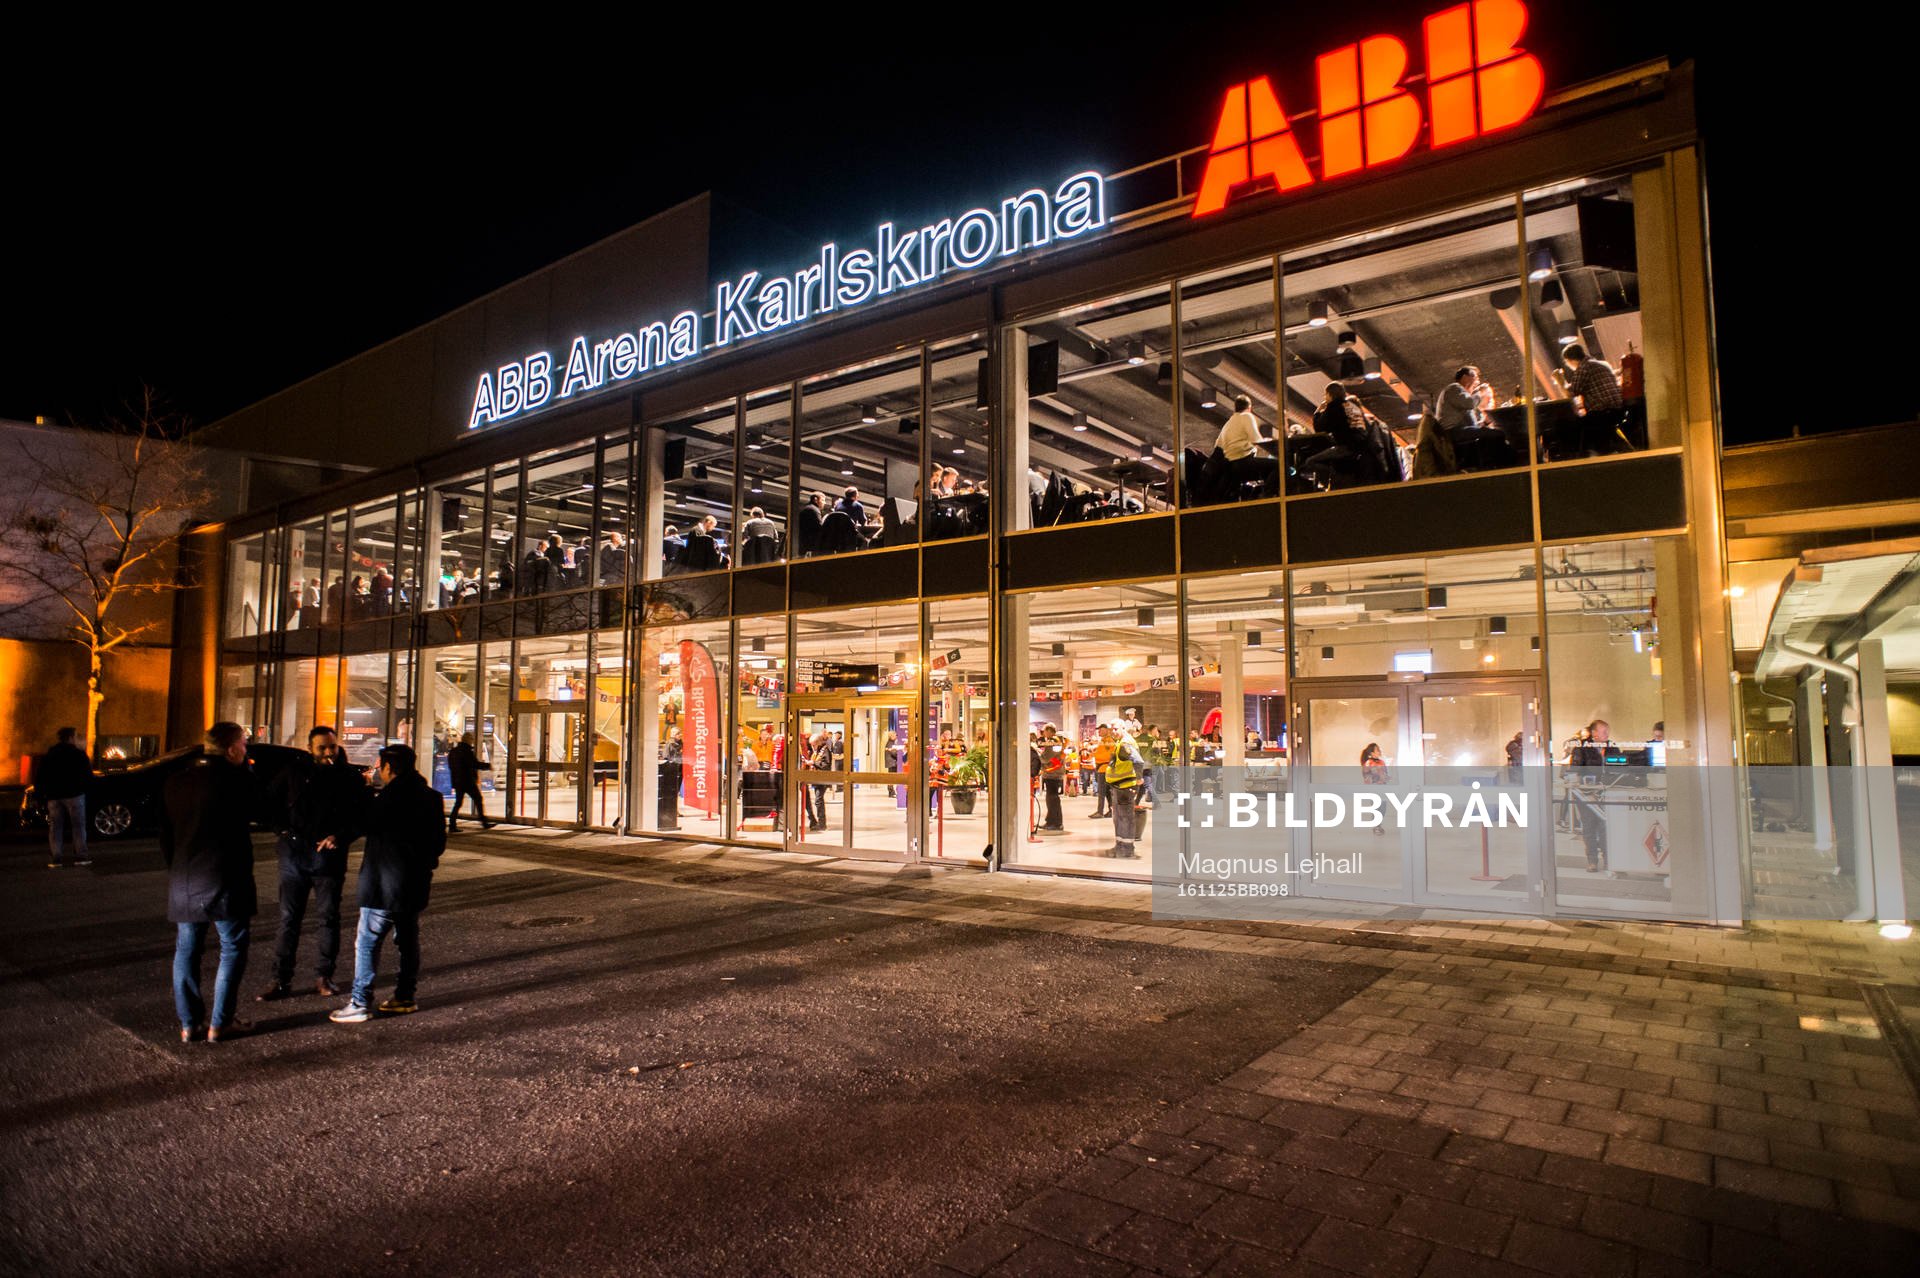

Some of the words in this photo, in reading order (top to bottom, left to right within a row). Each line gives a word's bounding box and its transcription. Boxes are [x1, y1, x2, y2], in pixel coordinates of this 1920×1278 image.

[1192, 0, 1544, 217] ABB
[469, 352, 551, 428] ABB
[561, 311, 698, 397] Arena
[715, 171, 1105, 347] Karlskrona
